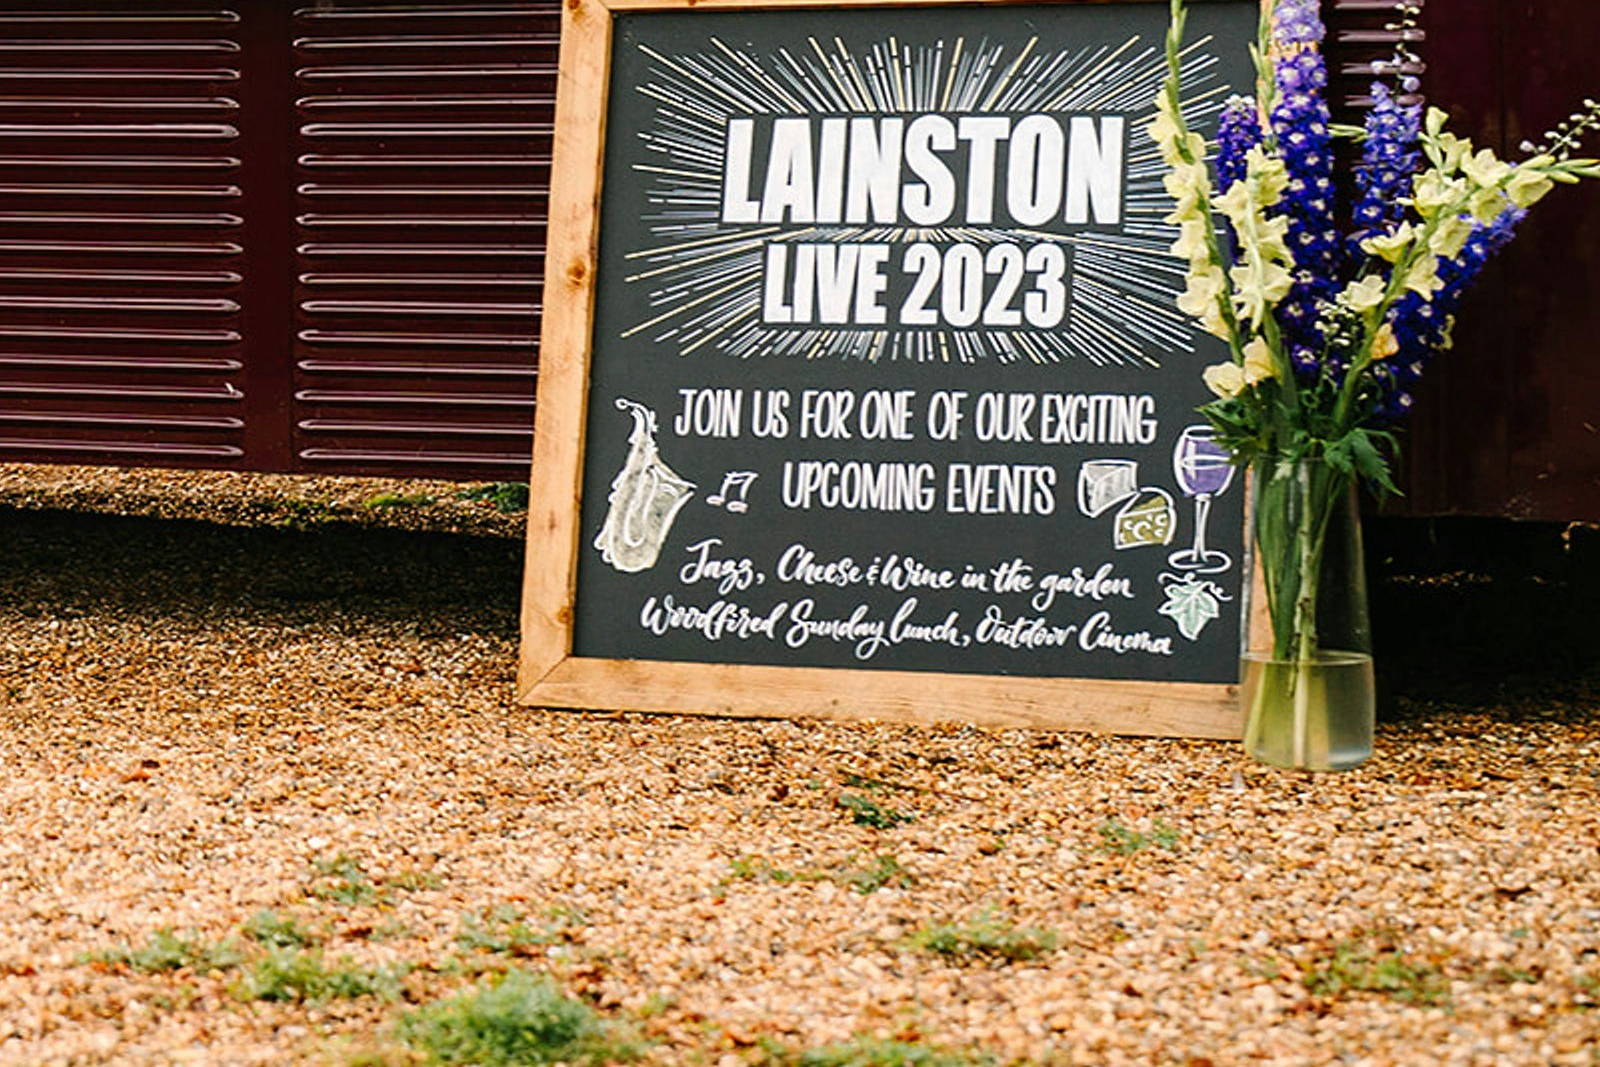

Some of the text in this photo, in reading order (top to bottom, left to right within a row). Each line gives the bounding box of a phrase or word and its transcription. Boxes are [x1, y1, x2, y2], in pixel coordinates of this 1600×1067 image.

[722, 115, 1124, 225] LAINSTON
[763, 243, 1066, 328] LIVE 2023
[674, 389, 1157, 444] JOIN US FOR ONE OF OUR EXCITING
[783, 461, 1056, 515] UPCOMING EVENTS
[680, 539, 765, 594] Jazz,
[778, 544, 863, 586] Cheese
[881, 554, 956, 591] Wine
[961, 565, 988, 592] in
[990, 558, 1034, 593] the
[1032, 563, 1135, 611] garden
[641, 595, 788, 640] Woodfired
[786, 599, 890, 659] Sunday
[976, 605, 1077, 648] Outdoor
[1080, 611, 1174, 655] Cinema
